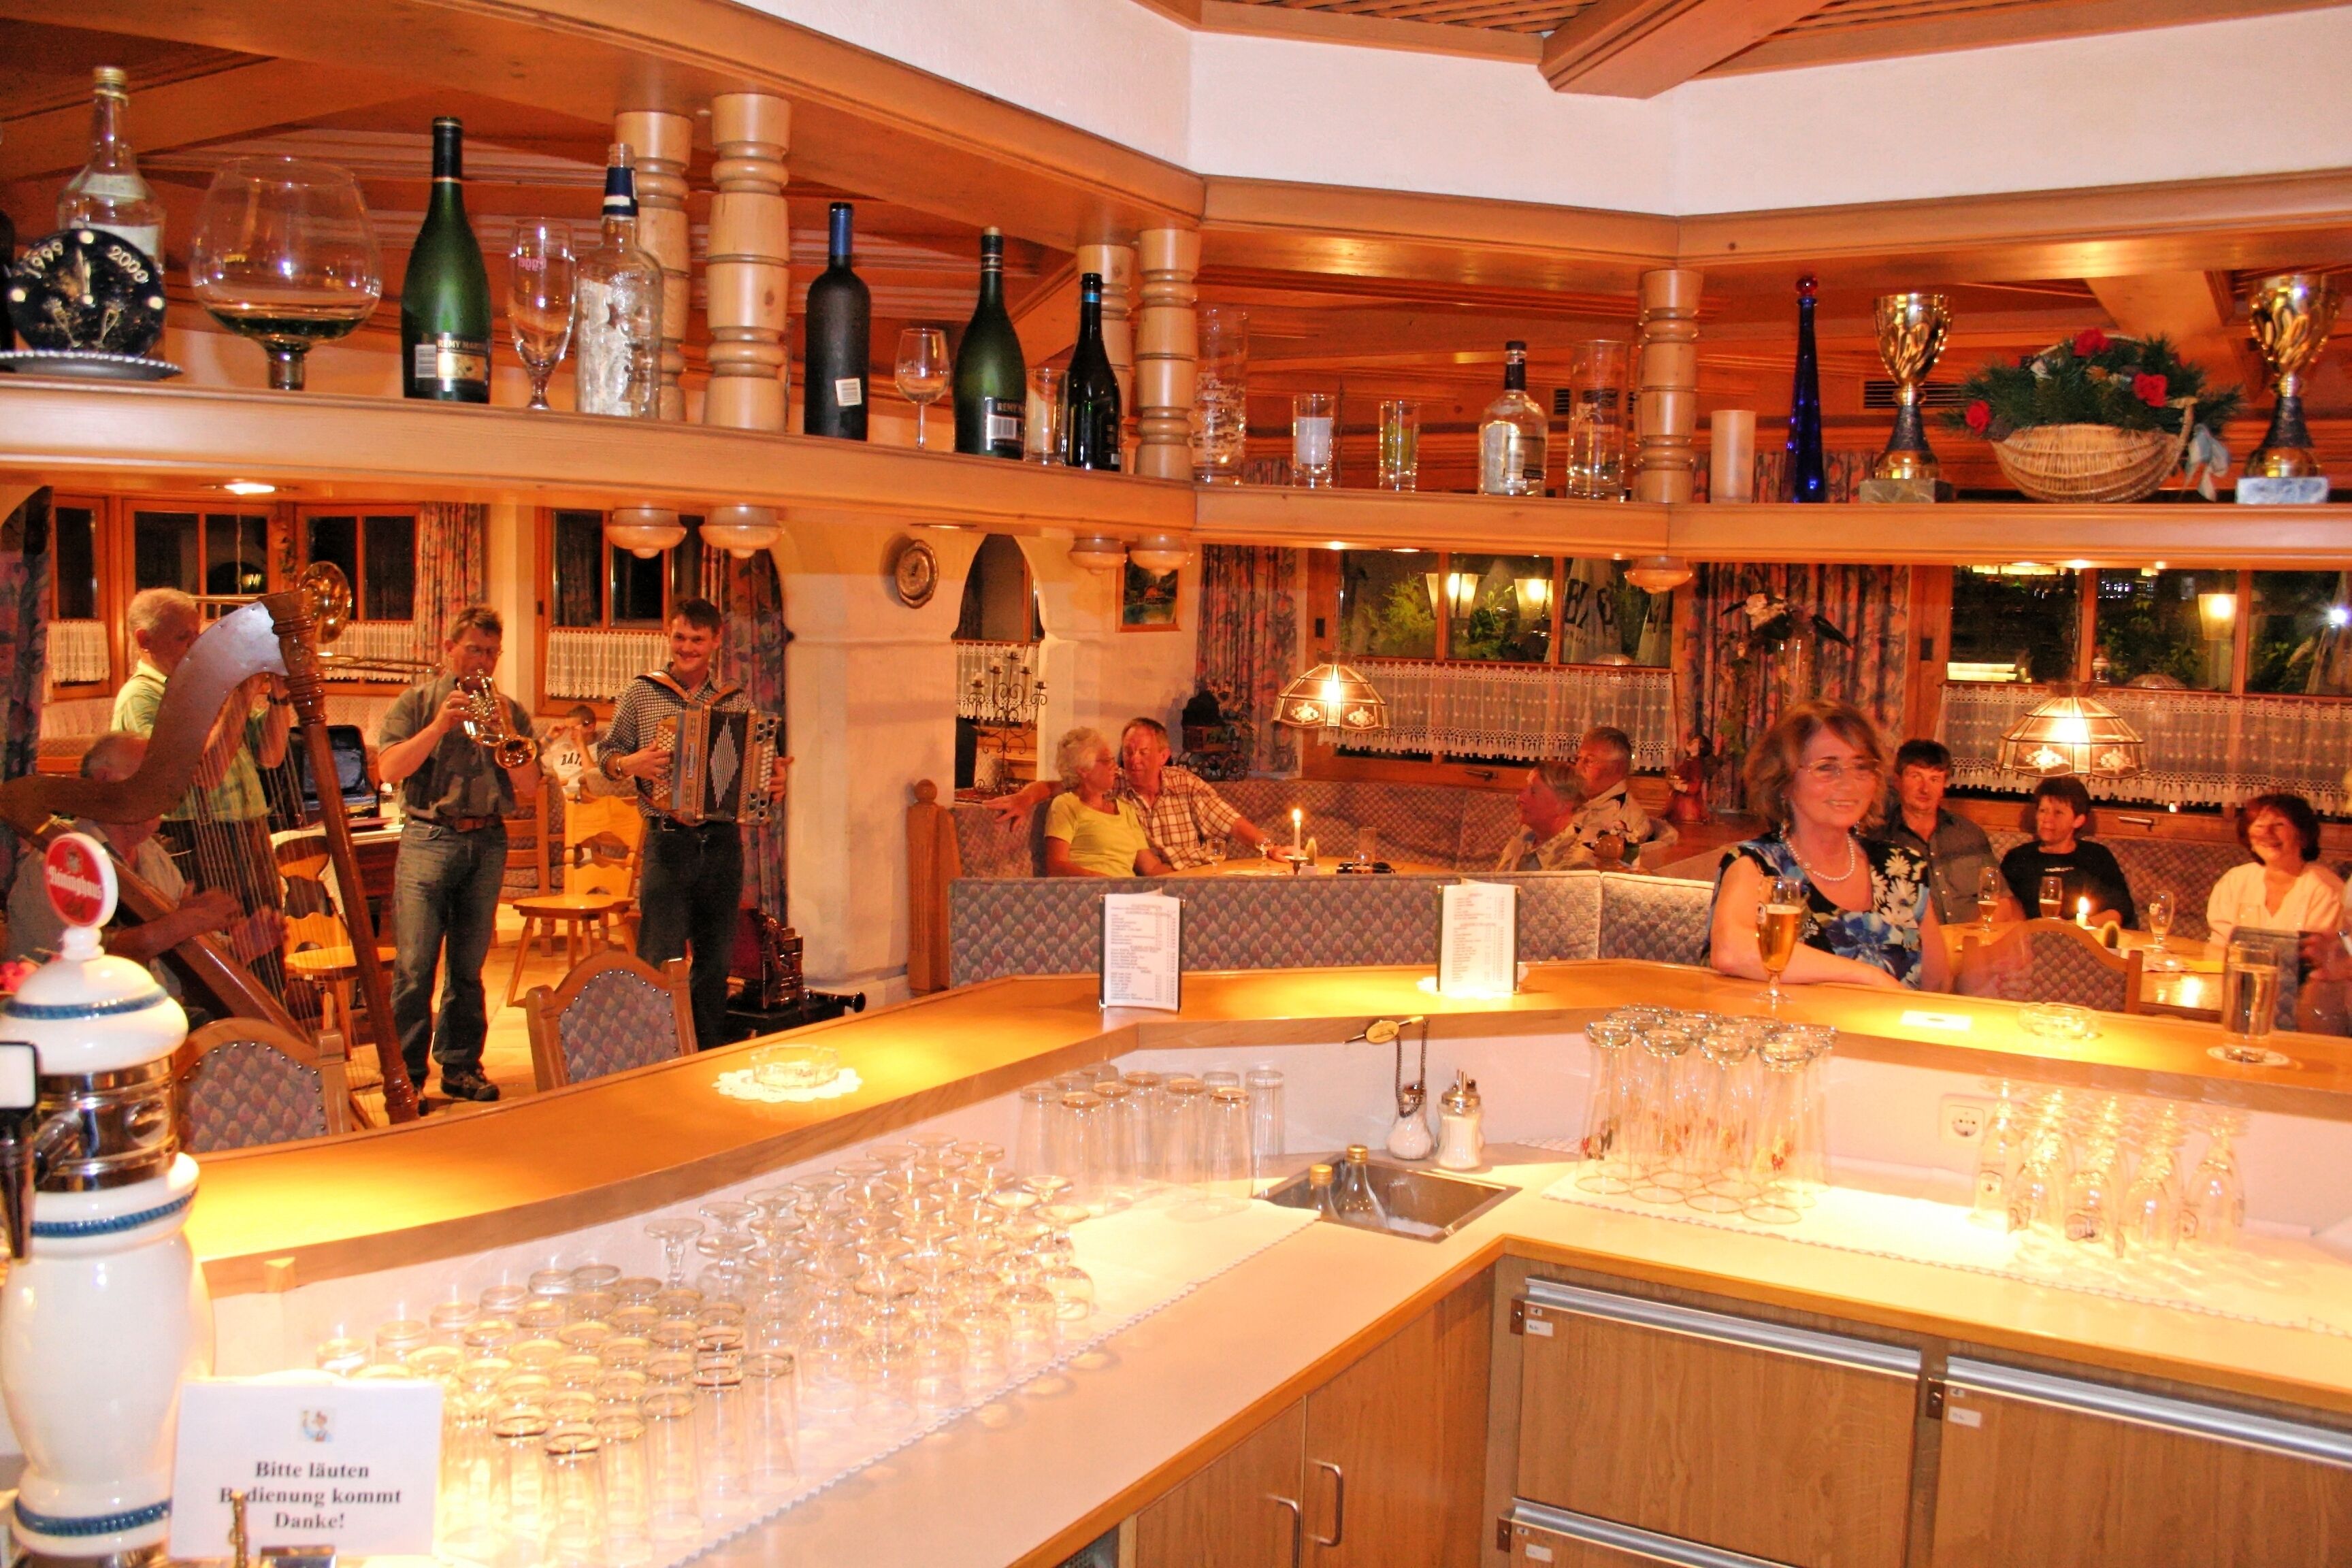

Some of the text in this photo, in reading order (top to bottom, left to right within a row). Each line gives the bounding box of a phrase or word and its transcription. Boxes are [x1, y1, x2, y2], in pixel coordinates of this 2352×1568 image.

[107, 244, 149, 283] 2000
[255, 1461, 370, 1478] Bitte läuten
[219, 1487, 402, 1507] Bdienung kommt
[274, 1512, 345, 1529] Danke!
